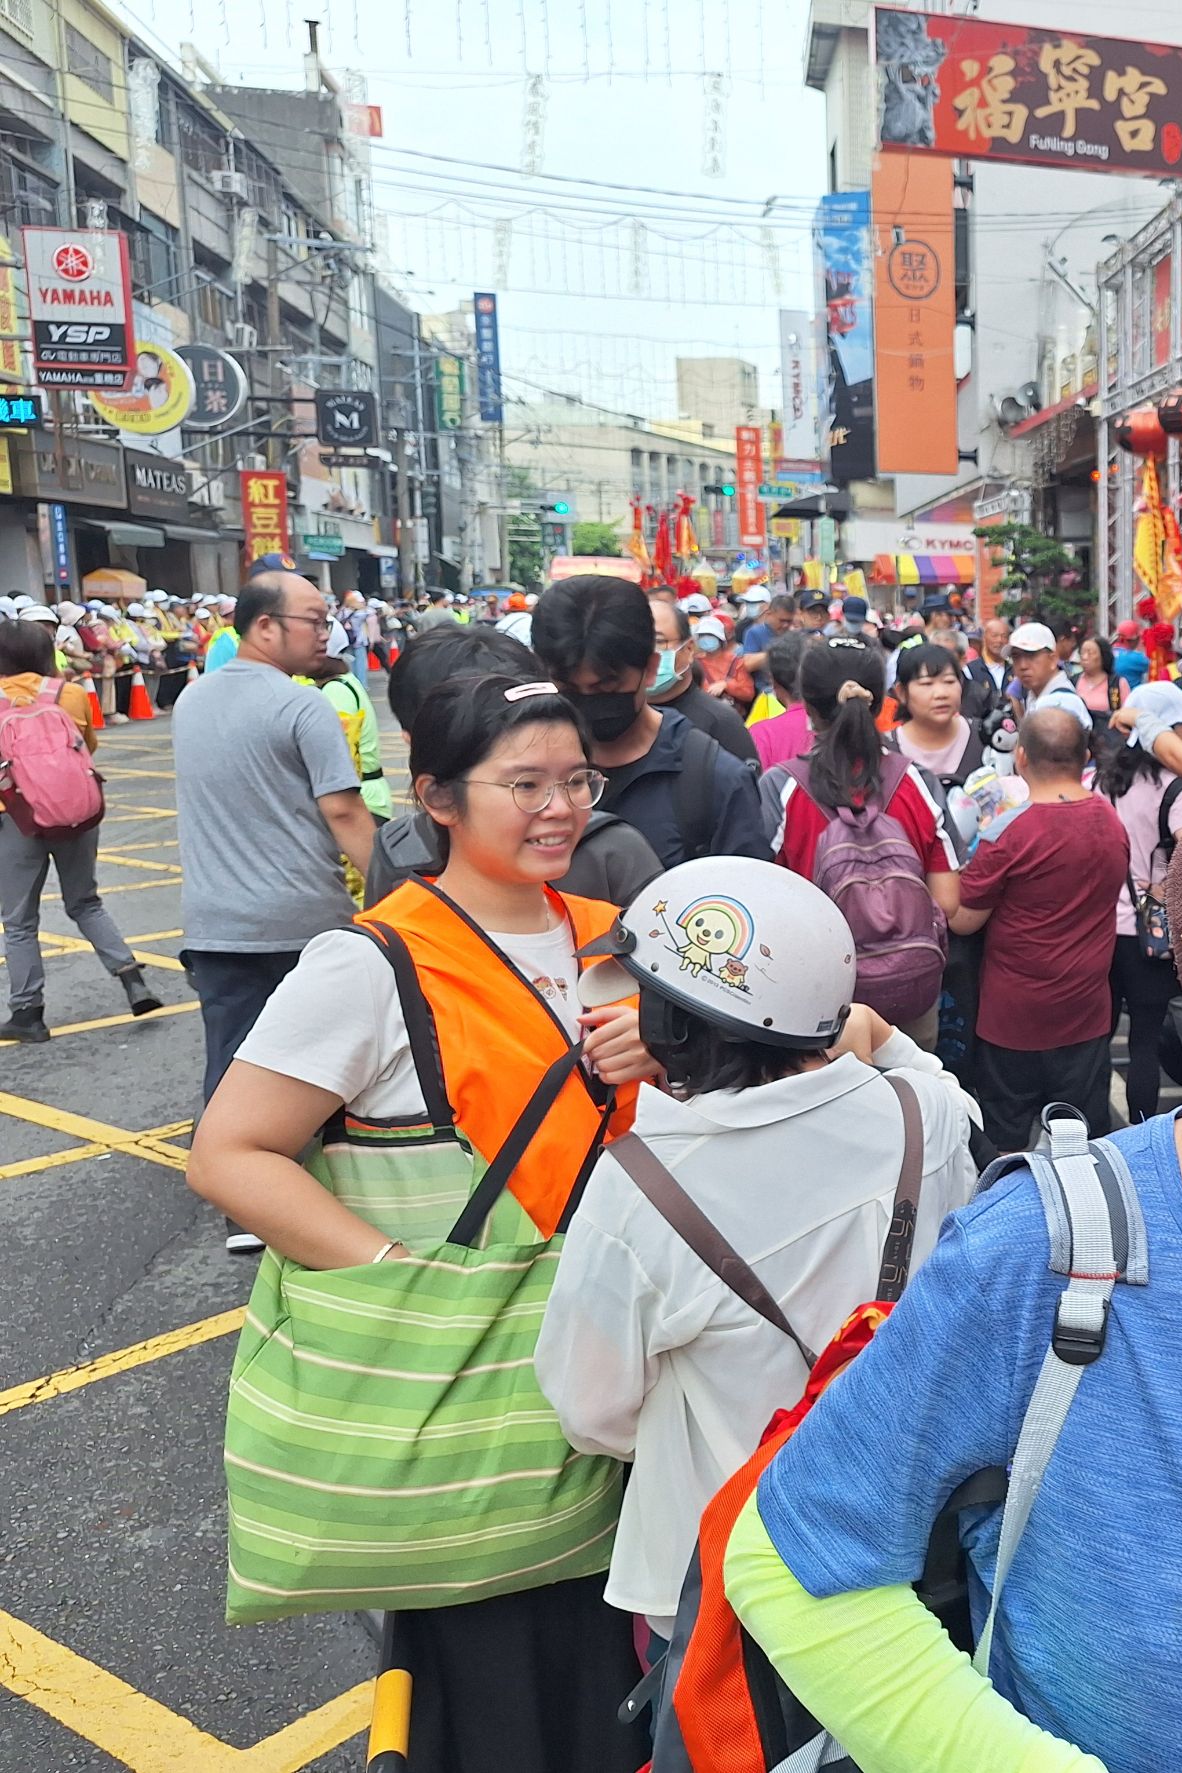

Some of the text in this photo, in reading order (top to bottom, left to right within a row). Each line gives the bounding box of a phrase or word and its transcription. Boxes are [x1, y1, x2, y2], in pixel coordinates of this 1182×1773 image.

[952, 39, 1168, 152] 福寧宮
[38, 287, 114, 307] YAMAHA
[48, 324, 111, 344] YSP
[134, 463, 188, 496] MATEAS
[247, 478, 283, 562] 紅豆餅
